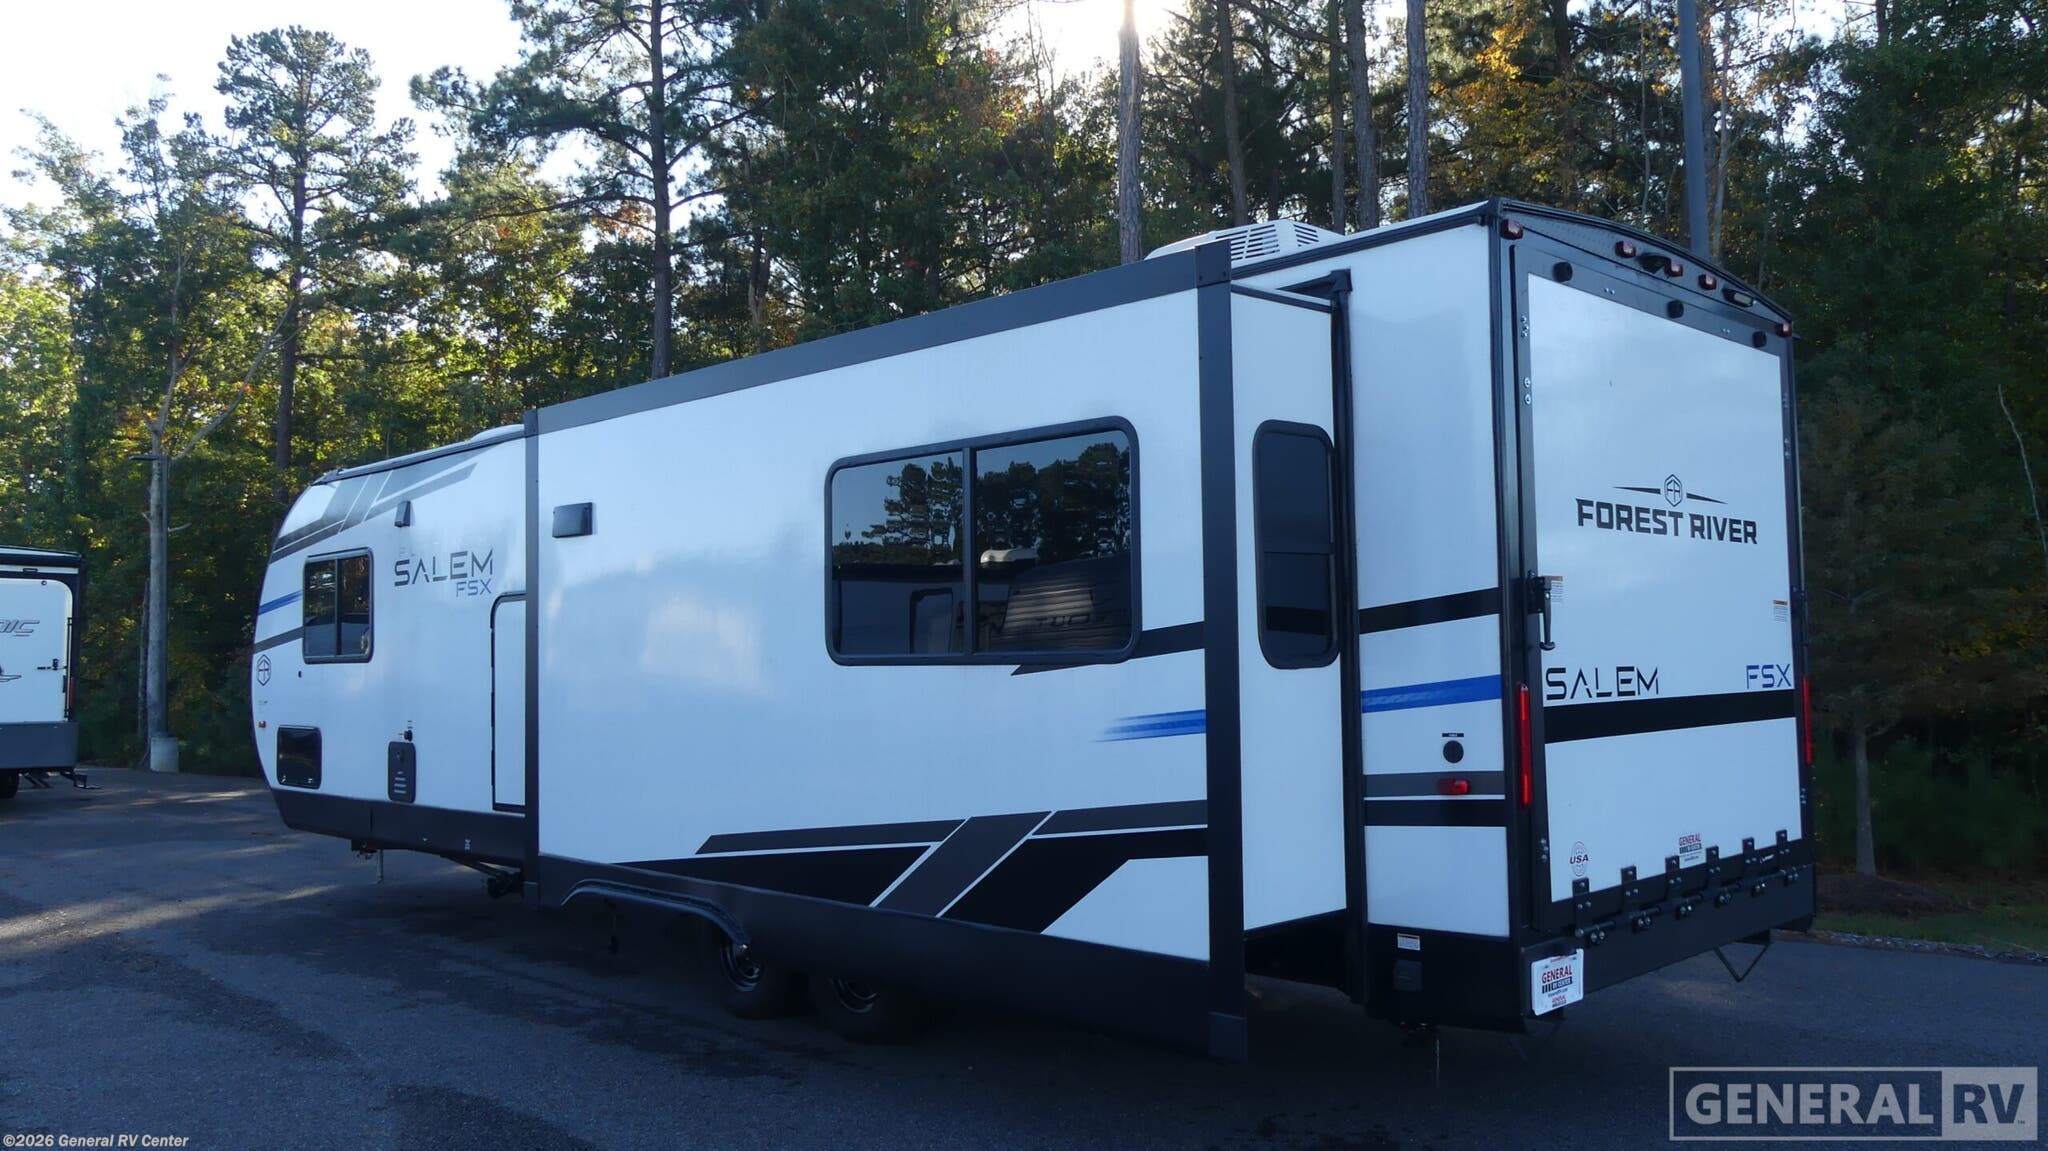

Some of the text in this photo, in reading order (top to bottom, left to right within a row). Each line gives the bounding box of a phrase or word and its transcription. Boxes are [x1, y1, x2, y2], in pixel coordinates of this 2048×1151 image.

[1575, 498, 1758, 545] FOREST RIVER
[394, 548, 493, 587] SALEM
[456, 578, 492, 597] FSX
[1546, 666, 1659, 701] SALEM
[1746, 664, 1792, 690] FSX
[1679, 833, 1701, 847] GENERAL
[1570, 854, 1589, 864] USA
[1542, 964, 1572, 984] GENERAL
